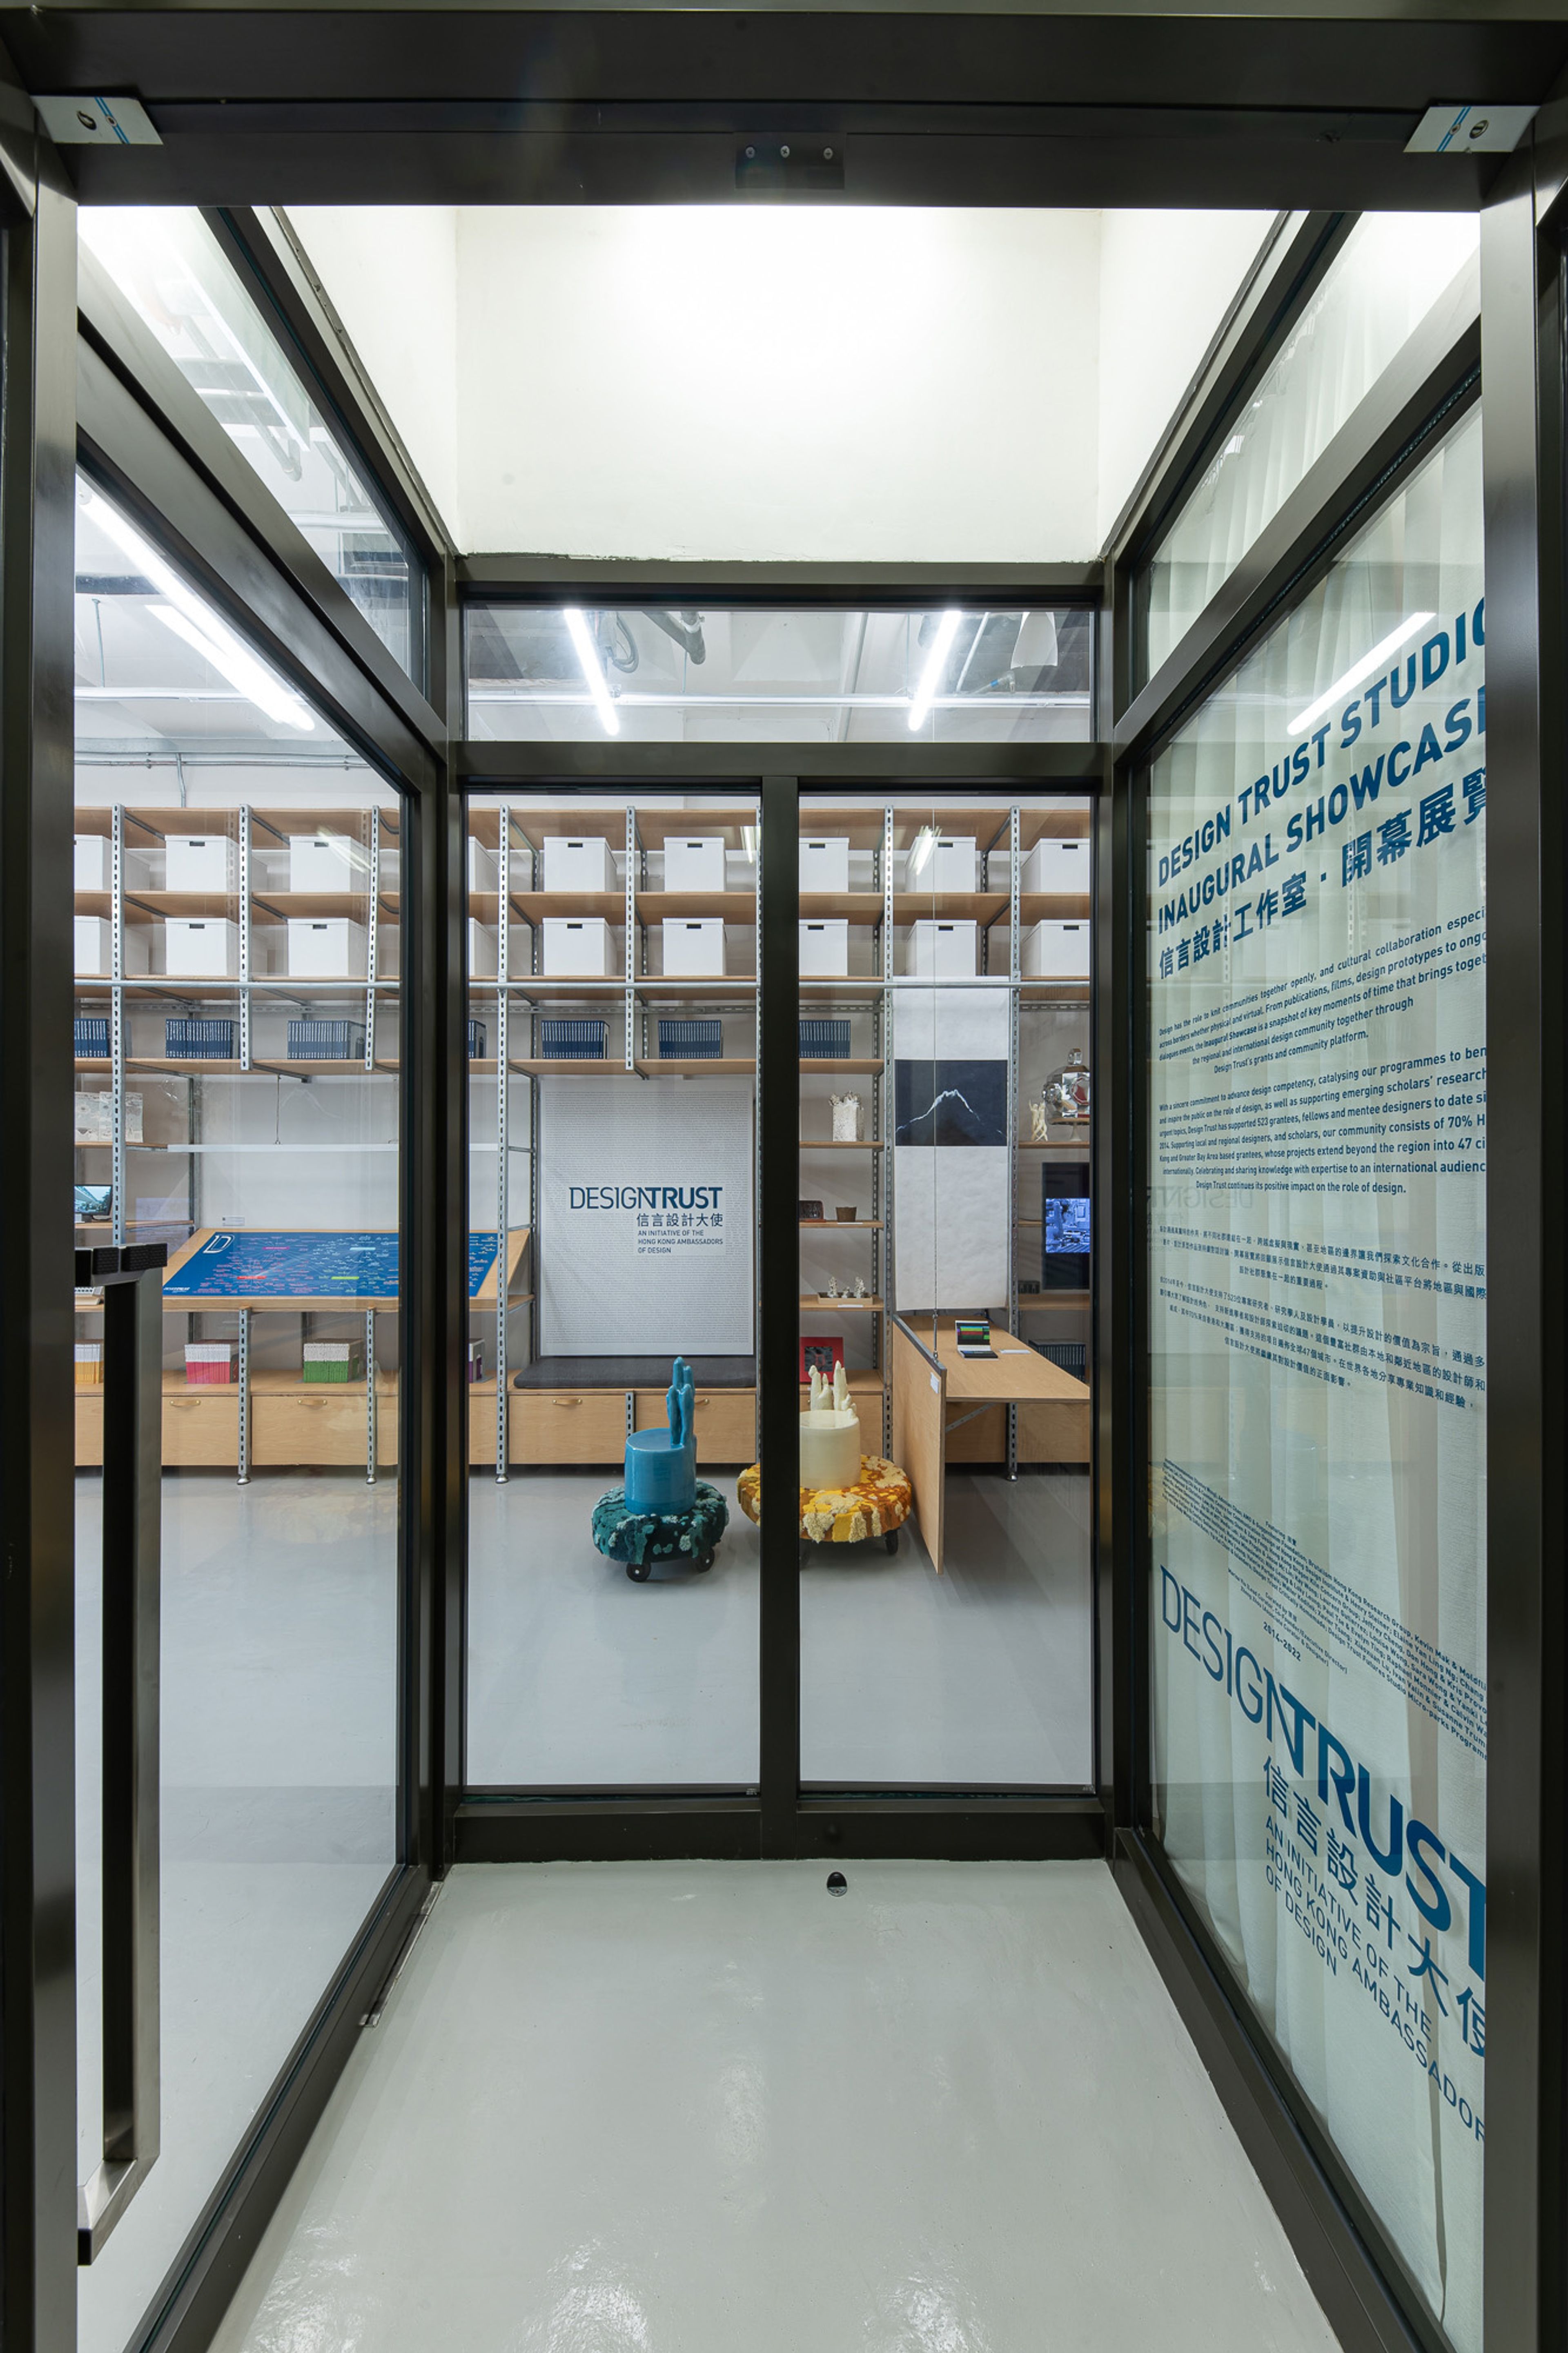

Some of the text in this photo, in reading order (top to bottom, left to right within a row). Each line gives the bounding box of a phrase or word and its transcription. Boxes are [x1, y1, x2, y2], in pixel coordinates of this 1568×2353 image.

[1159, 804, 1230, 887] DESIGN
[1238, 722, 1330, 825] TRUST
[1159, 685, 1486, 935] INAUGURAL SHOWCAS
[1261, 982, 1287, 998] together
[1291, 972, 1316, 988] openly,
[1320, 963, 1334, 977] and
[1338, 949, 1370, 970] cultural
[1376, 925, 1441, 956] collaboration
[1448, 906, 1484, 930] especi
[1266, 1001, 1282, 1013] From
[1285, 986, 1330, 1008] publications,
[1331, 977, 1354, 991] films,
[1356, 966, 1385, 983] design
[1388, 946, 1443, 974] prototypes
[1446, 942, 1456, 952] to
[1269, 1012, 1299, 1028] snapshot
[1300, 1008, 1307, 1018] of
[1309, 1006, 1321, 1016] key
[1323, 993, 1361, 1011] moments
[1363, 988, 1371, 999] of
[1373, 984, 1394, 996] time
[1396, 975, 1415, 989] that
[1418, 965, 1452, 983] brings
[1271, 1031, 1292, 1043] design
[1294, 1020, 1334, 1037] community
[1337, 1009, 1373, 1026] together
[1376, 996, 1413, 1015] through
[1275, 1048, 1287, 1059] and
[1288, 1039, 1328, 1055] community
[1330, 1030, 1368, 1048] platform.
[1273, 1078, 1315, 1092] competency,
[1319, 1070, 1359, 1084] catalysing
[1362, 1067, 1376, 1077] our
[1380, 1054, 1446, 1076] programmes
[1450, 1051, 1461, 1062] to
[1269, 1115, 1300, 1127] grantees,
[1302, 1111, 1328, 1121] fellows
[1331, 1107, 1345, 1118] and
[1348, 1105, 1380, 1117] mentee
[1382, 1100, 1431, 1113] designers
[1434, 1097, 1444, 1107] to
[1448, 1094, 1472, 1106] date
[1274, 1097, 1287, 1108] well
[1300, 1092, 1339, 1106] supporting
[1342, 1086, 1383, 1098] emerging
[1265, 1149, 1285, 1157] whose
[1287, 1147, 1315, 1159] projects
[1317, 1145, 1343, 1155] extend
[1345, 1143, 1376, 1156] beyond
[1380, 1142, 1394, 1153] the
[1398, 1142, 1430, 1154] region
[1434, 1140, 1454, 1150] into
[1458, 1137, 1472, 1149] 47
[1274, 1131, 1286, 1140] and
[1288, 1130, 1320, 1140] scholars,
[1323, 1129, 1336, 1137] our
[1339, 1124, 1386, 1136] community
[1389, 1120, 1430, 1132] consists
[1434, 1117, 1443, 1129] of
[1448, 1115, 1472, 1128] 70%
[1258, 1165, 1292, 1175] knowledge
[1294, 1164, 1309, 1173] with
[1311, 1164, 1347, 1175] expertise
[1350, 1164, 1358, 1173] to
[1374, 1161, 1437, 1172] international
[1265, 1182, 1289, 1191] positive
[1291, 1182, 1314, 1192] impact
[1327, 1182, 1340, 1191] the
[1342, 1182, 1359, 1192] role
[1361, 1182, 1370, 1192] of
[1372, 1182, 1406, 1195] design.
[569, 1187, 723, 1209] DESIGNTRUST
[637, 1213, 723, 1227] 信言設計大使
[1266, 1844, 1302, 1898] HONG
[1307, 1899, 1348, 1960] KONG
[1266, 1865, 1337, 1976] OF DESIGN
[1266, 1815, 1432, 2042] AN INITIATIVE OF THE
